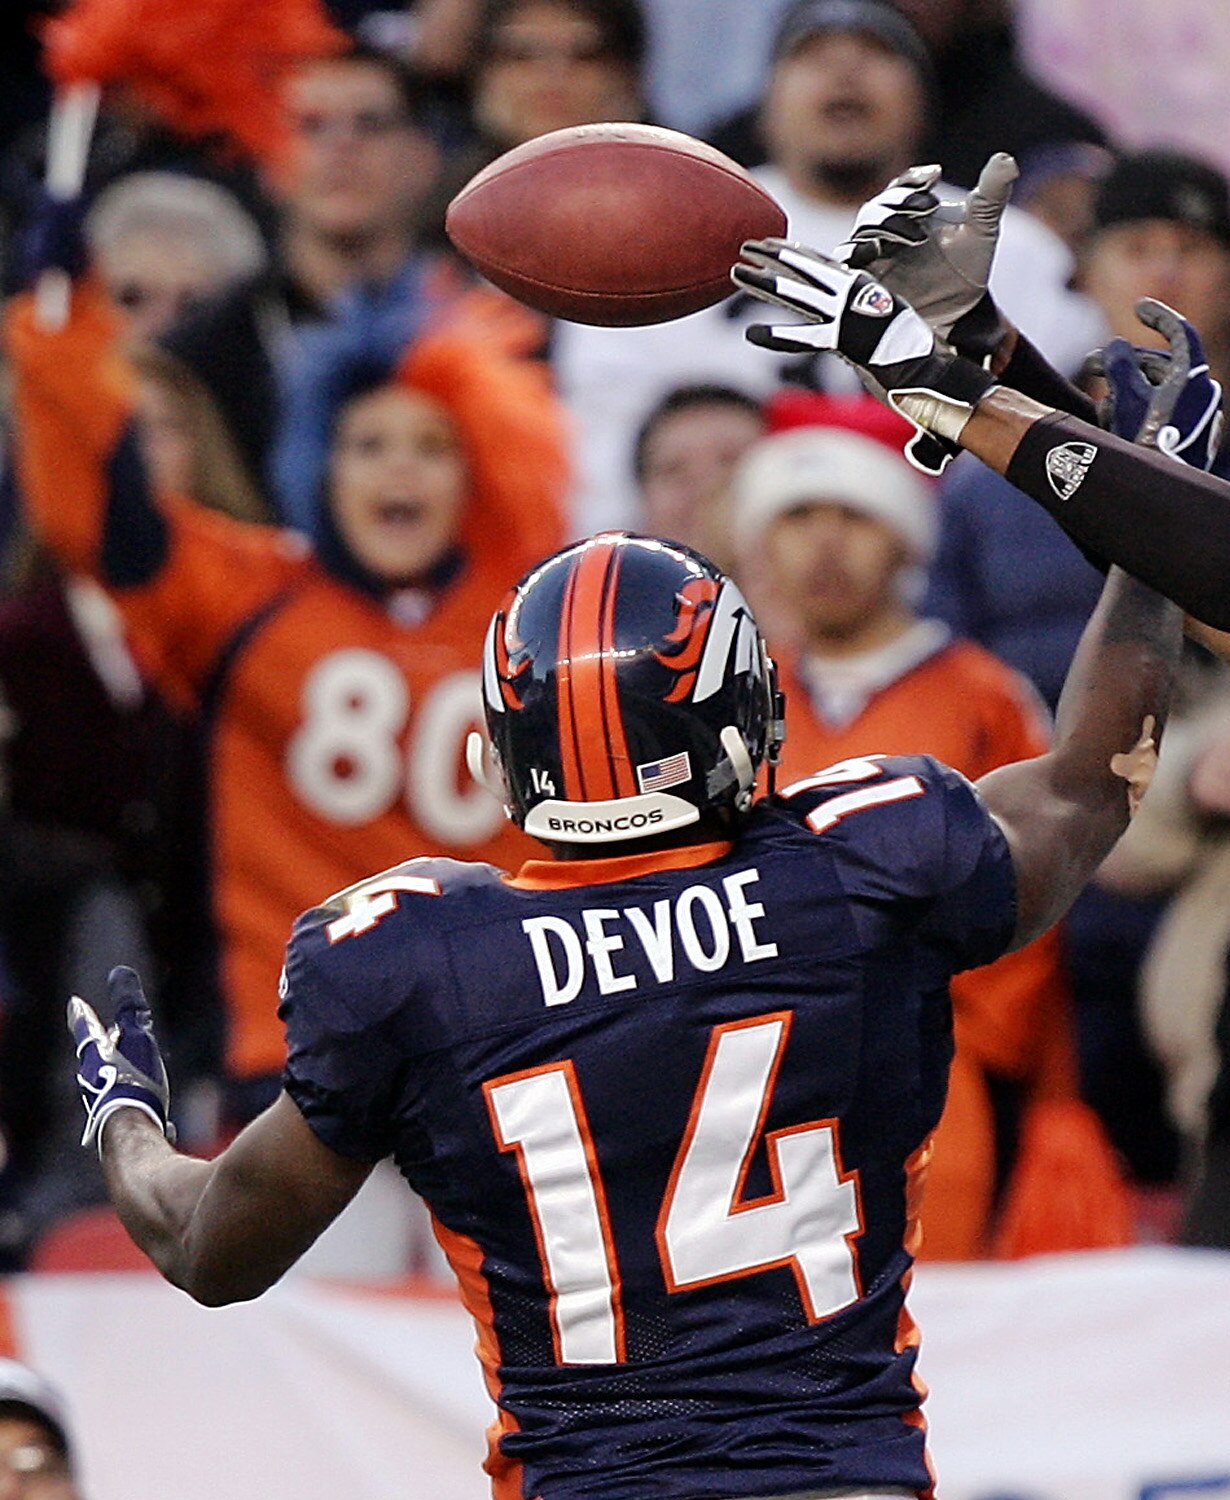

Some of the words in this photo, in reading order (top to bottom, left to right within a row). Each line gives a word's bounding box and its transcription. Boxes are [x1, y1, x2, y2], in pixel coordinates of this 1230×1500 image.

[285, 645, 508, 848] 80
[530, 768, 556, 796] 14
[548, 809, 664, 835] BRONCOS
[521, 867, 779, 1008] DEVOE
[481, 1009, 866, 1366] 14
